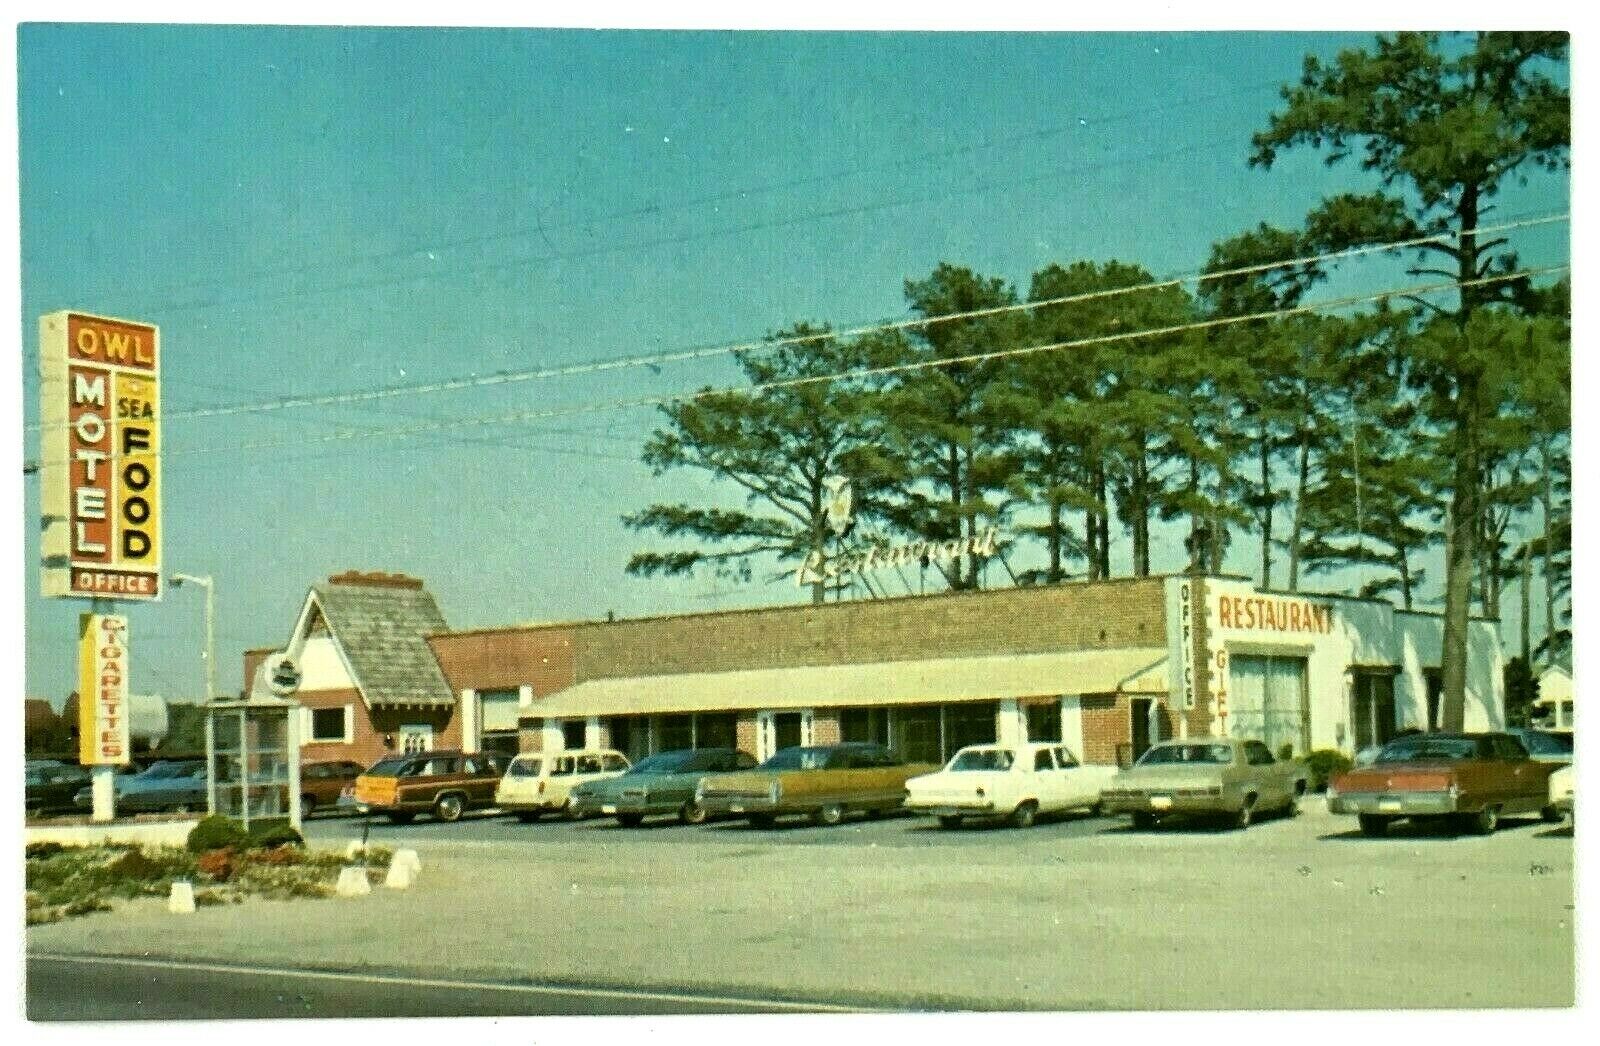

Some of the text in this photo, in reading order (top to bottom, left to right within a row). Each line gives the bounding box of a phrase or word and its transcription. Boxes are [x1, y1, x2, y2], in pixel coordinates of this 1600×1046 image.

[77, 328, 152, 364] OWL
[116, 397, 153, 419] SEA
[75, 373, 106, 553] MOTEL
[122, 427, 151, 559] FOOD
[78, 572, 149, 593] OFFICE
[1219, 595, 1333, 634] RESTAURANT
[100, 617, 122, 757] CIGARETTES
[1181, 583, 1193, 706] OFFICE
[1216, 649, 1228, 736] GIFT
